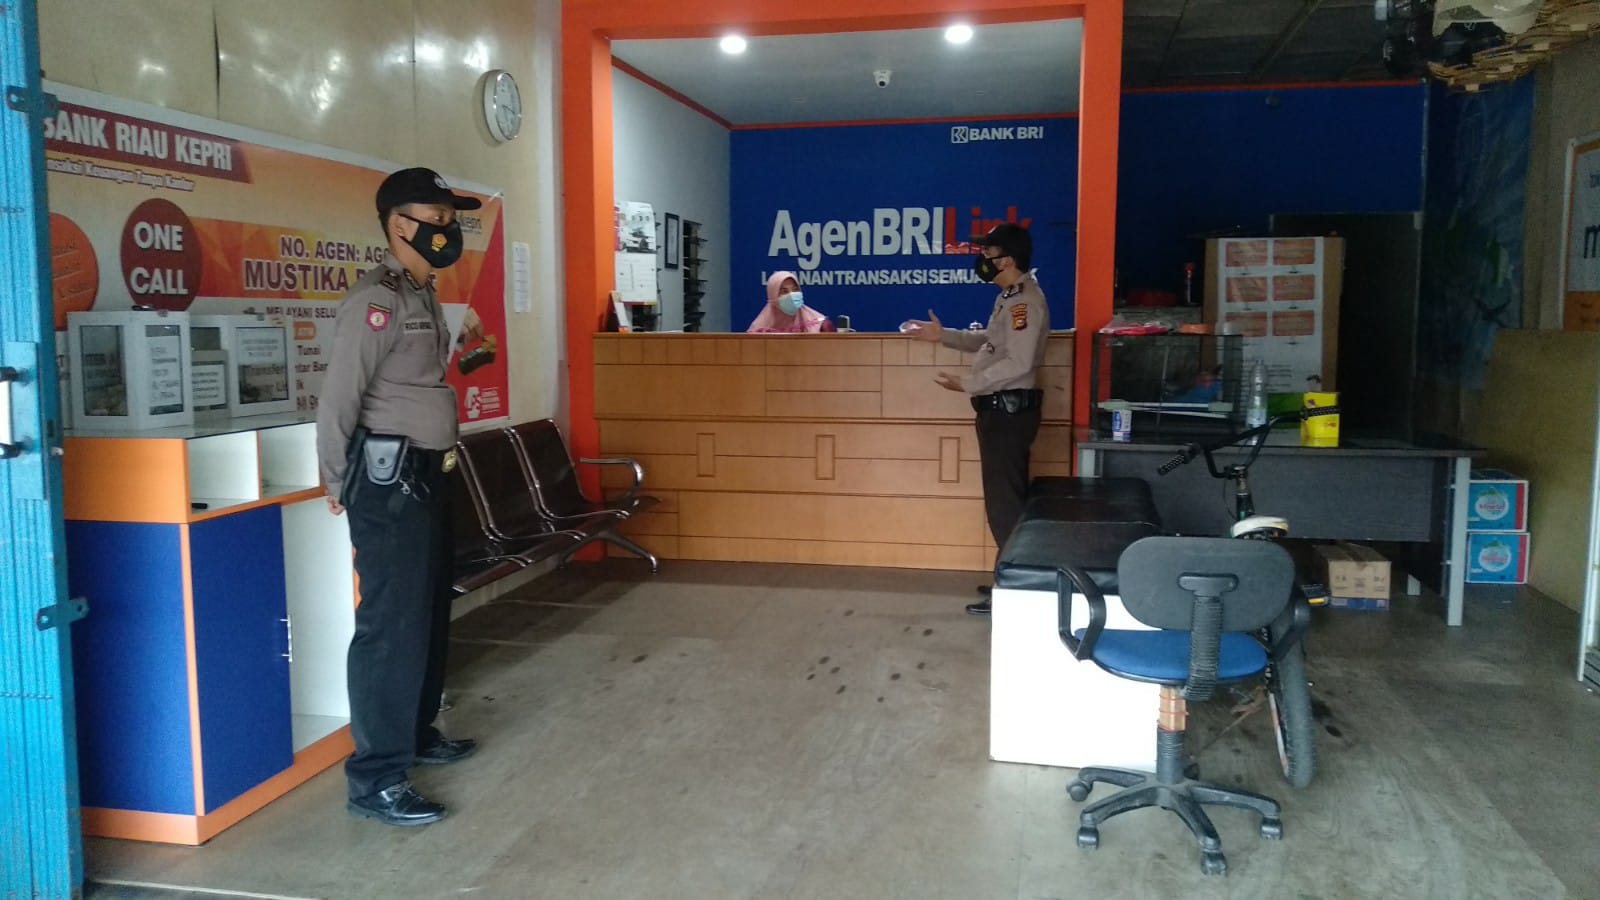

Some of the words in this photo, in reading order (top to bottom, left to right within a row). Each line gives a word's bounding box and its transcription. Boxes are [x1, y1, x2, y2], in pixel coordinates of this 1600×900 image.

[115, 121, 169, 160] RIAU
[174, 134, 232, 171] KEPRI
[969, 127, 1014, 141] BANK
[1017, 125, 1044, 139] BRI
[133, 221, 184, 251] ONE
[281, 236, 309, 258] NO.
[315, 241, 360, 262] AGEN:
[130, 266, 189, 295] CALL
[245, 261, 349, 291] MUSTIKA
[834, 269, 928, 286] TRANSAKSI
